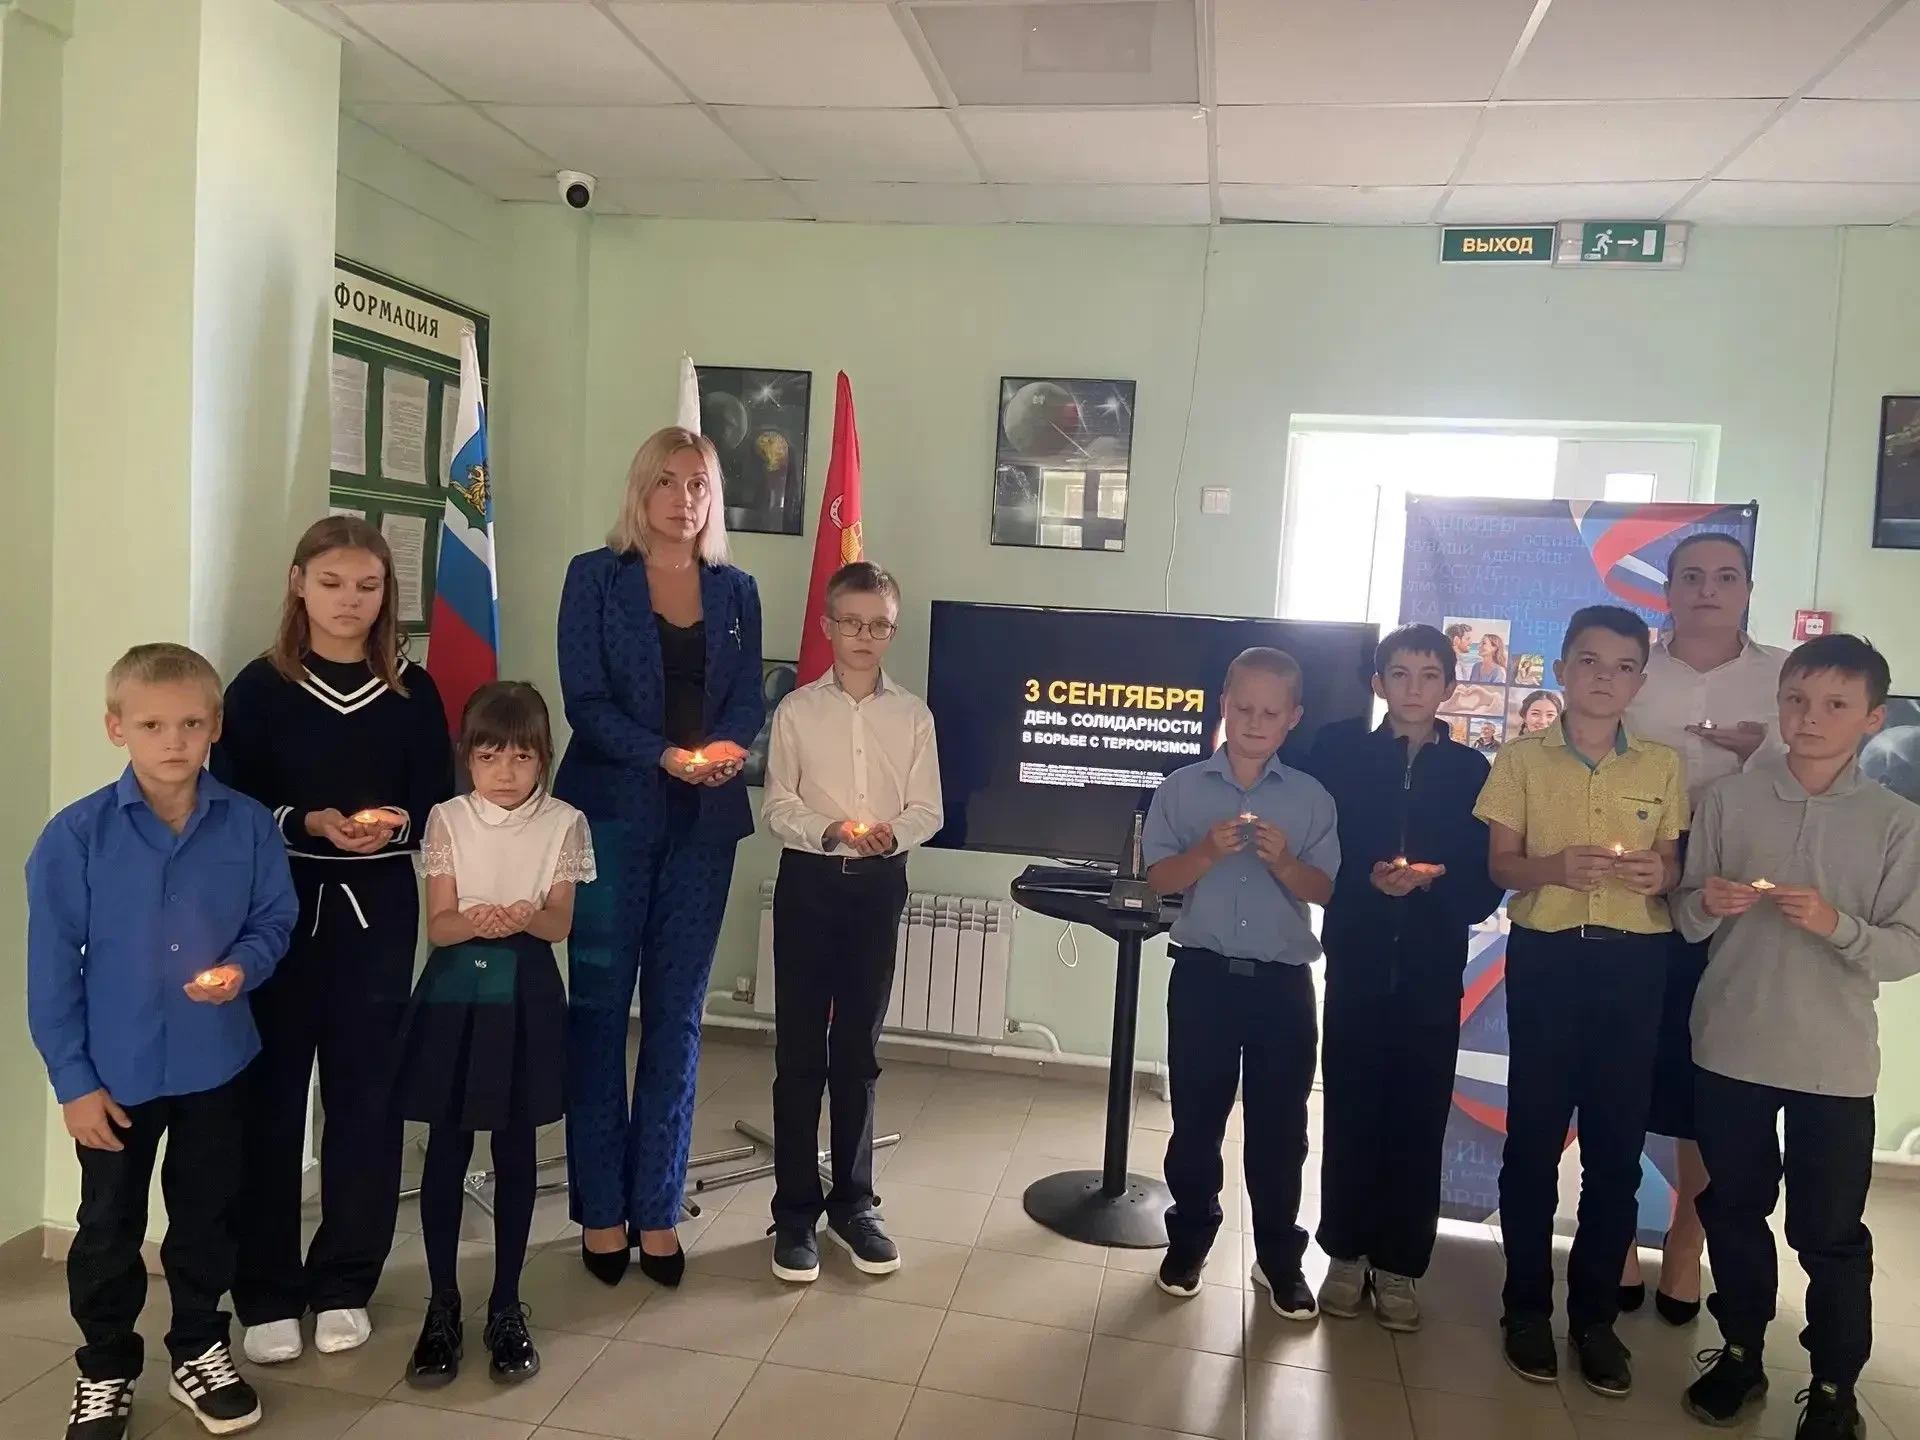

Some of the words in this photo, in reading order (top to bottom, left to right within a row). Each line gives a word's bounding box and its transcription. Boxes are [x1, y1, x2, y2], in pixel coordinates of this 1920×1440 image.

[1463, 237, 1533, 254] ВЫХОД
[1024, 679, 1040, 702] 3
[1049, 681, 1205, 713] СЕНТЯБРЯ
[1024, 710, 1067, 726] ДЕНЬ
[1071, 713, 1203, 735] СОЛИДАРНОСТИ
[1022, 732, 1032, 743] В
[1035, 732, 1087, 747] БОРЬБЕ
[1090, 736, 1100, 748] С
[1101, 737, 1201, 755] ТЕРРОРИЗМОМ
